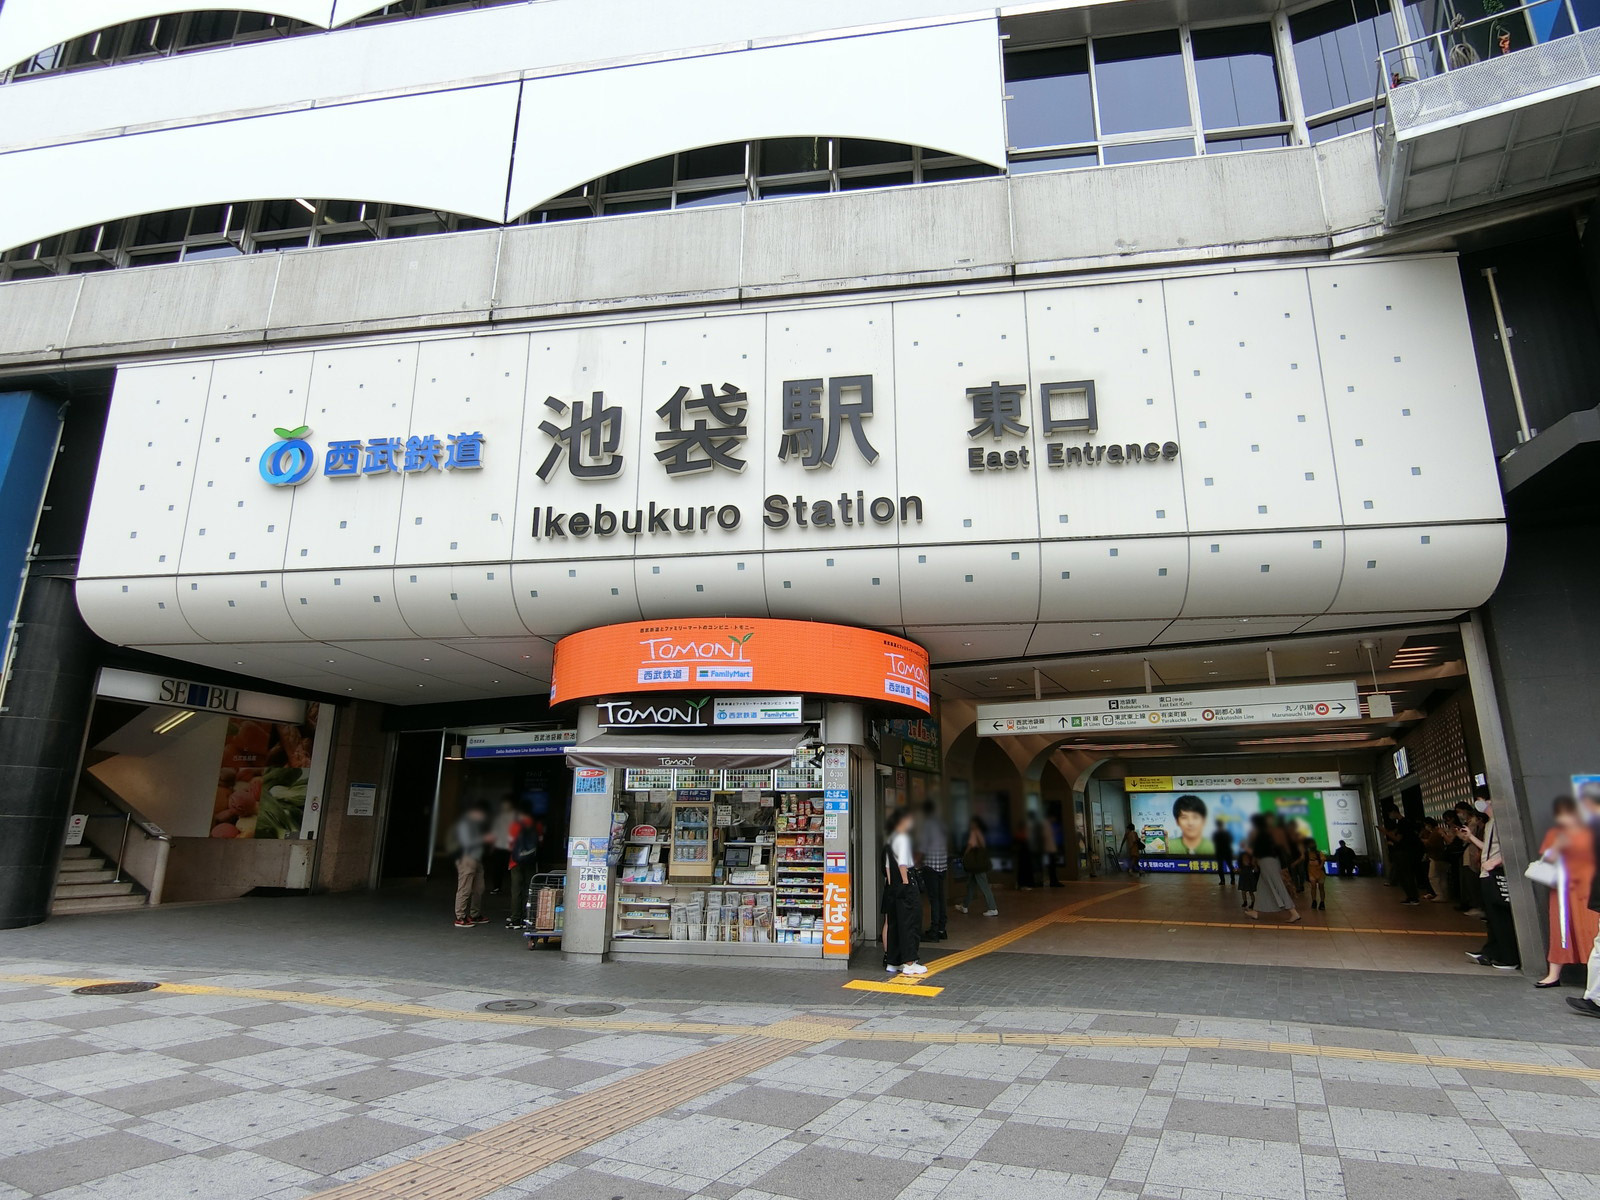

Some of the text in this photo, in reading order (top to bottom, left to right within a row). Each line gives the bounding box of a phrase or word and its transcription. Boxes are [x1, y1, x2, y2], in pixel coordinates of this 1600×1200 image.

[966, 380, 1098, 441] 東口
[535, 374, 880, 483] 池袋駅
[323, 431, 486, 478] 西武鉄道
[968, 441, 1180, 471] East Entrance
[531, 490, 923, 540] Ikebukuro Station
[640, 633, 754, 661] TOMONY
[643, 669, 682, 680] 西武鉄道
[710, 670, 750, 678] FamilyMart
[159, 679, 239, 712] SEIBU
[596, 696, 710, 725] TOMONY
[534, 733, 562, 742] 西武池袋線
[658, 756, 697, 765] TOMONY
[829, 770, 844, 778] 6:30
[826, 790, 847, 798] たばこ
[825, 882, 848, 945] たばこ
